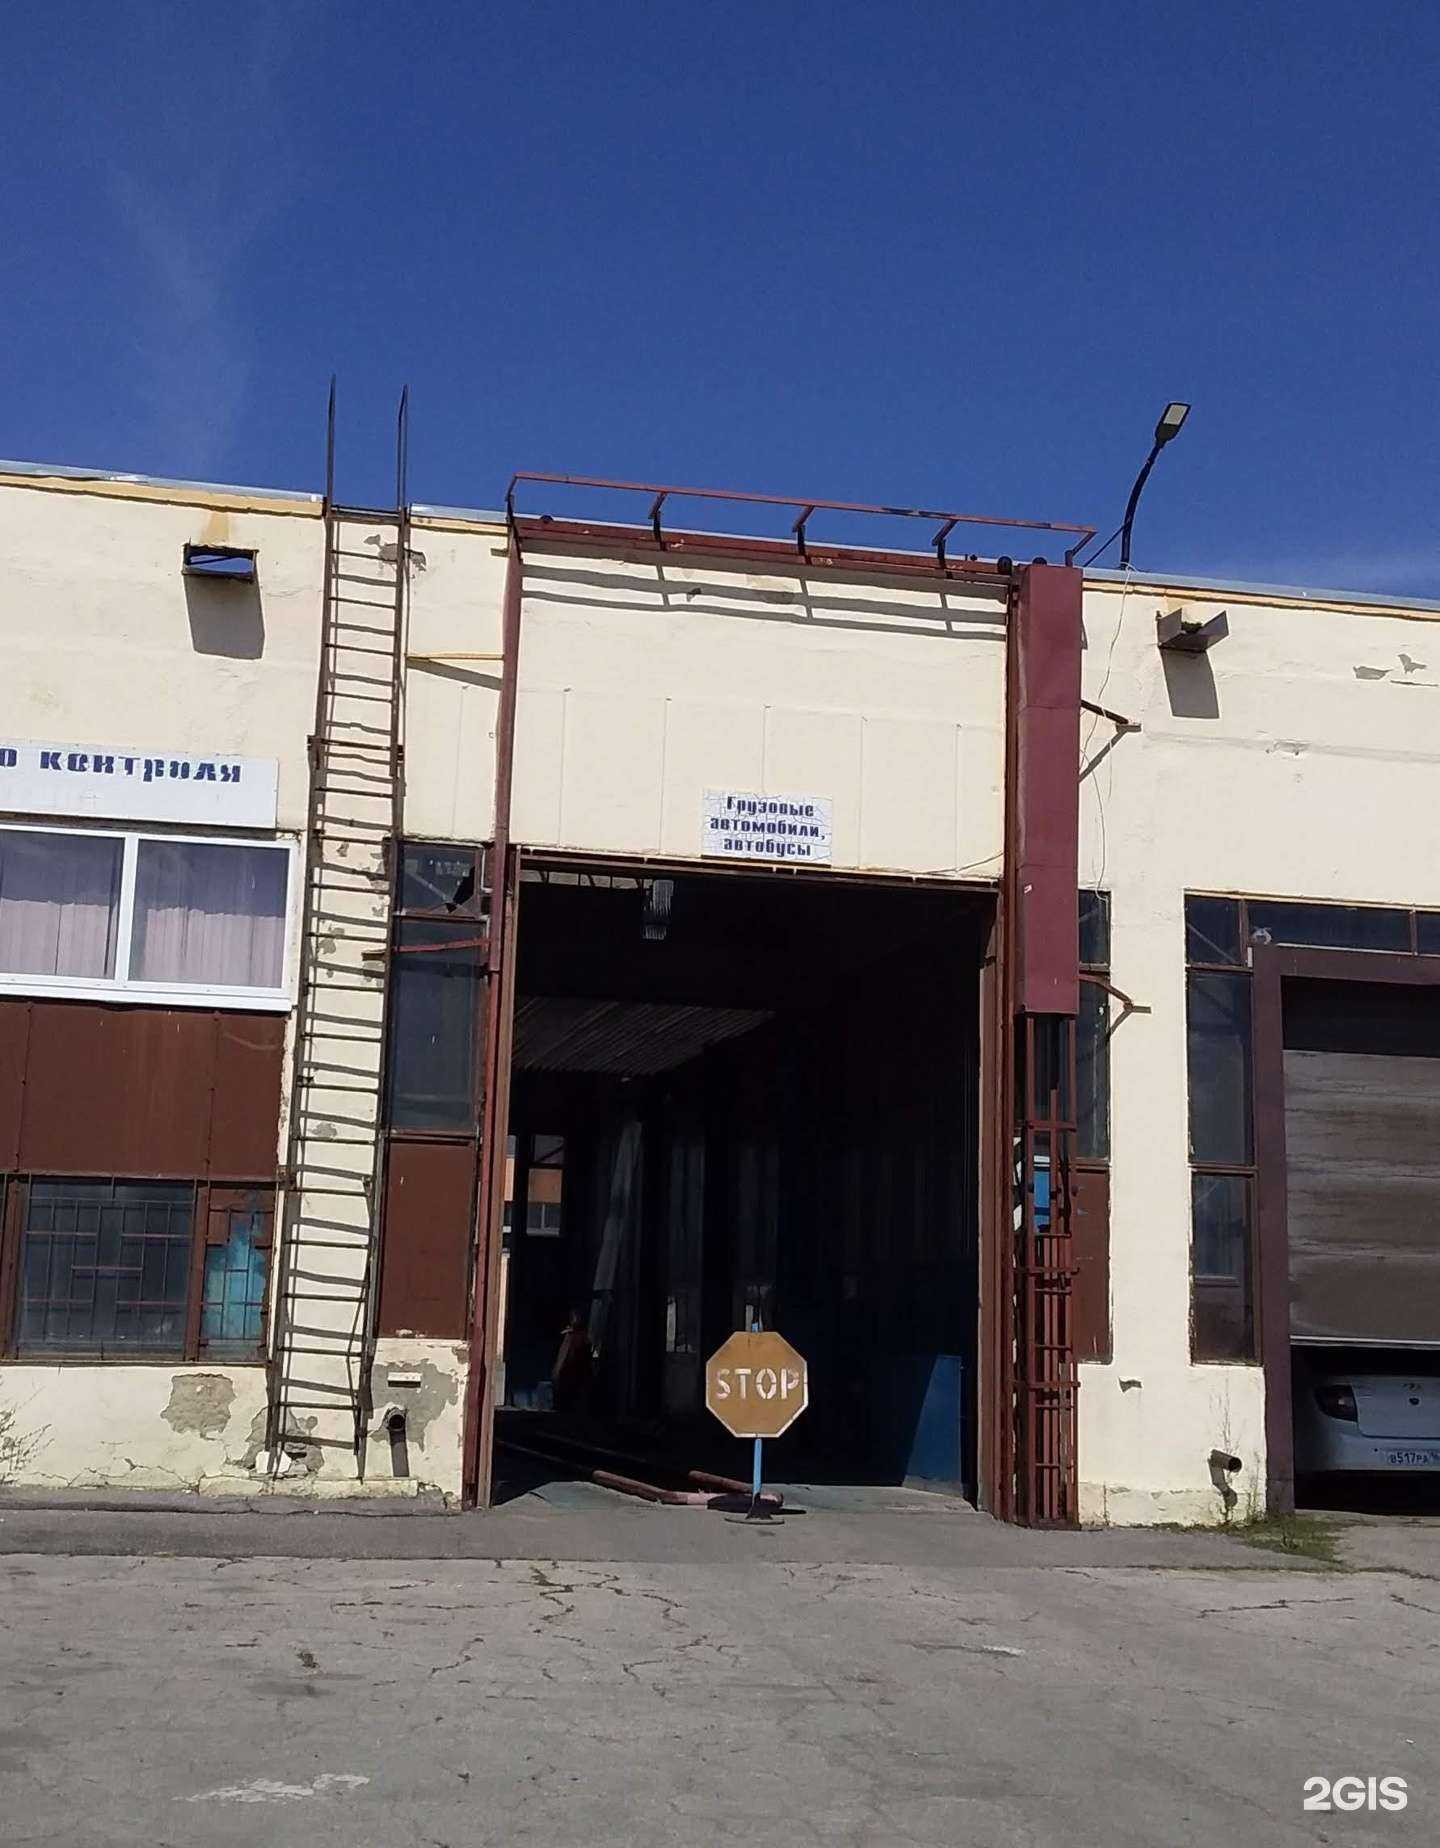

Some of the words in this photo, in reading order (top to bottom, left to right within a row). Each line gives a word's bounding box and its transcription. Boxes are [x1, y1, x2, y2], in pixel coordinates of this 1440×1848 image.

[726, 796, 814, 817] Грузовые
[710, 817, 826, 840] автомобили,
[723, 838, 811, 857] автобусы
[716, 1368, 800, 1400] STOP
